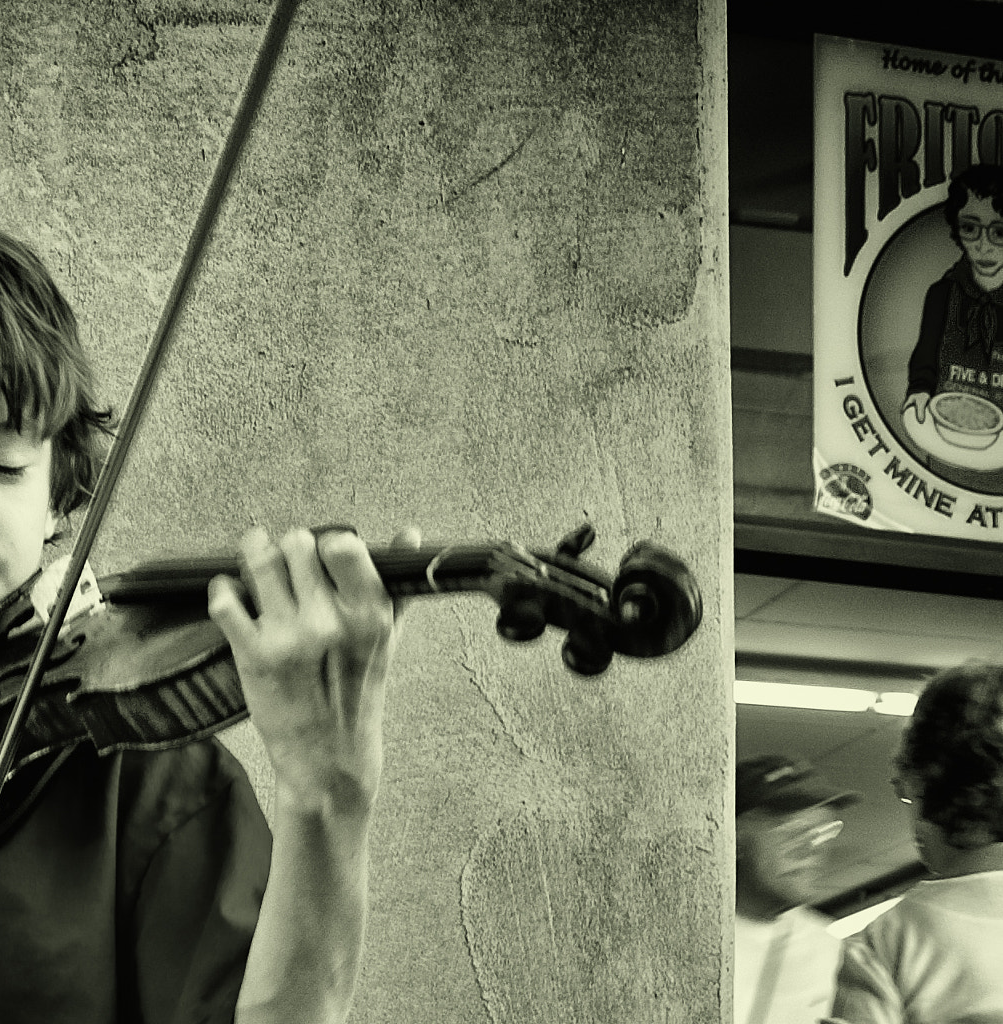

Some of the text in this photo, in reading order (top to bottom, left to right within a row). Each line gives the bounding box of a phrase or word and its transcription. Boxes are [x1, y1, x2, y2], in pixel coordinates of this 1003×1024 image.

[881, 49, 1003, 84] Home of th
[834, 376, 855, 387] I
[949, 365, 976, 382] FIVE
[979, 370, 988, 385] &
[843, 394, 890, 457] GET
[883, 455, 957, 519] MINE
[966, 503, 1003, 528] AT
